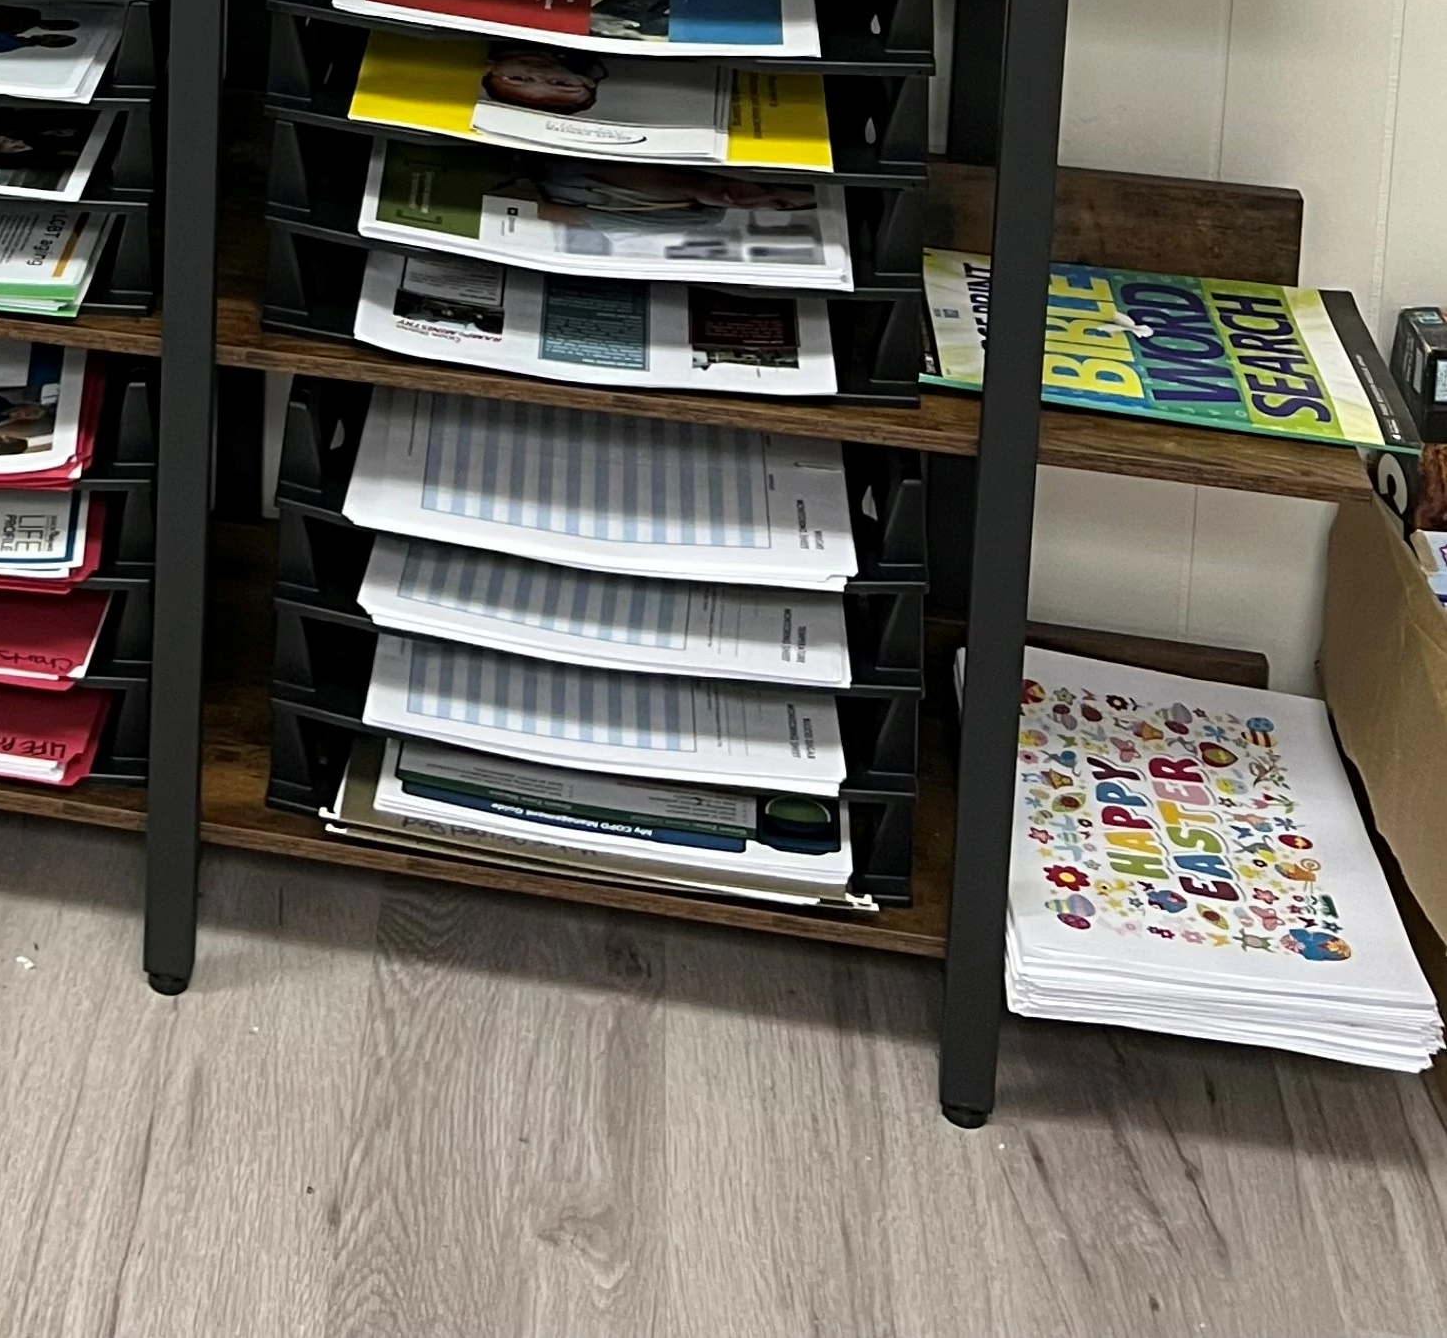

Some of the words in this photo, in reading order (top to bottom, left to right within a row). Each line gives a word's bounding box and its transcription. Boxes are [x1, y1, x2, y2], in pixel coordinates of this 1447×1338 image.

[1042, 271, 1144, 400] BIBLE
[1120, 282, 1242, 402] WORD
[1212, 293, 1330, 423] SEARCH
[15, 514, 46, 551] LIFE
[20, 740, 66, 760] LIFE
[491, 802, 523, 817] Guide
[525, 809, 599, 829] Management
[600, 820, 632, 835] COPD
[1087, 756, 1170, 880] HAPPY
[1149, 755, 1240, 901] EASTER
[633, 824, 653, 838] My
